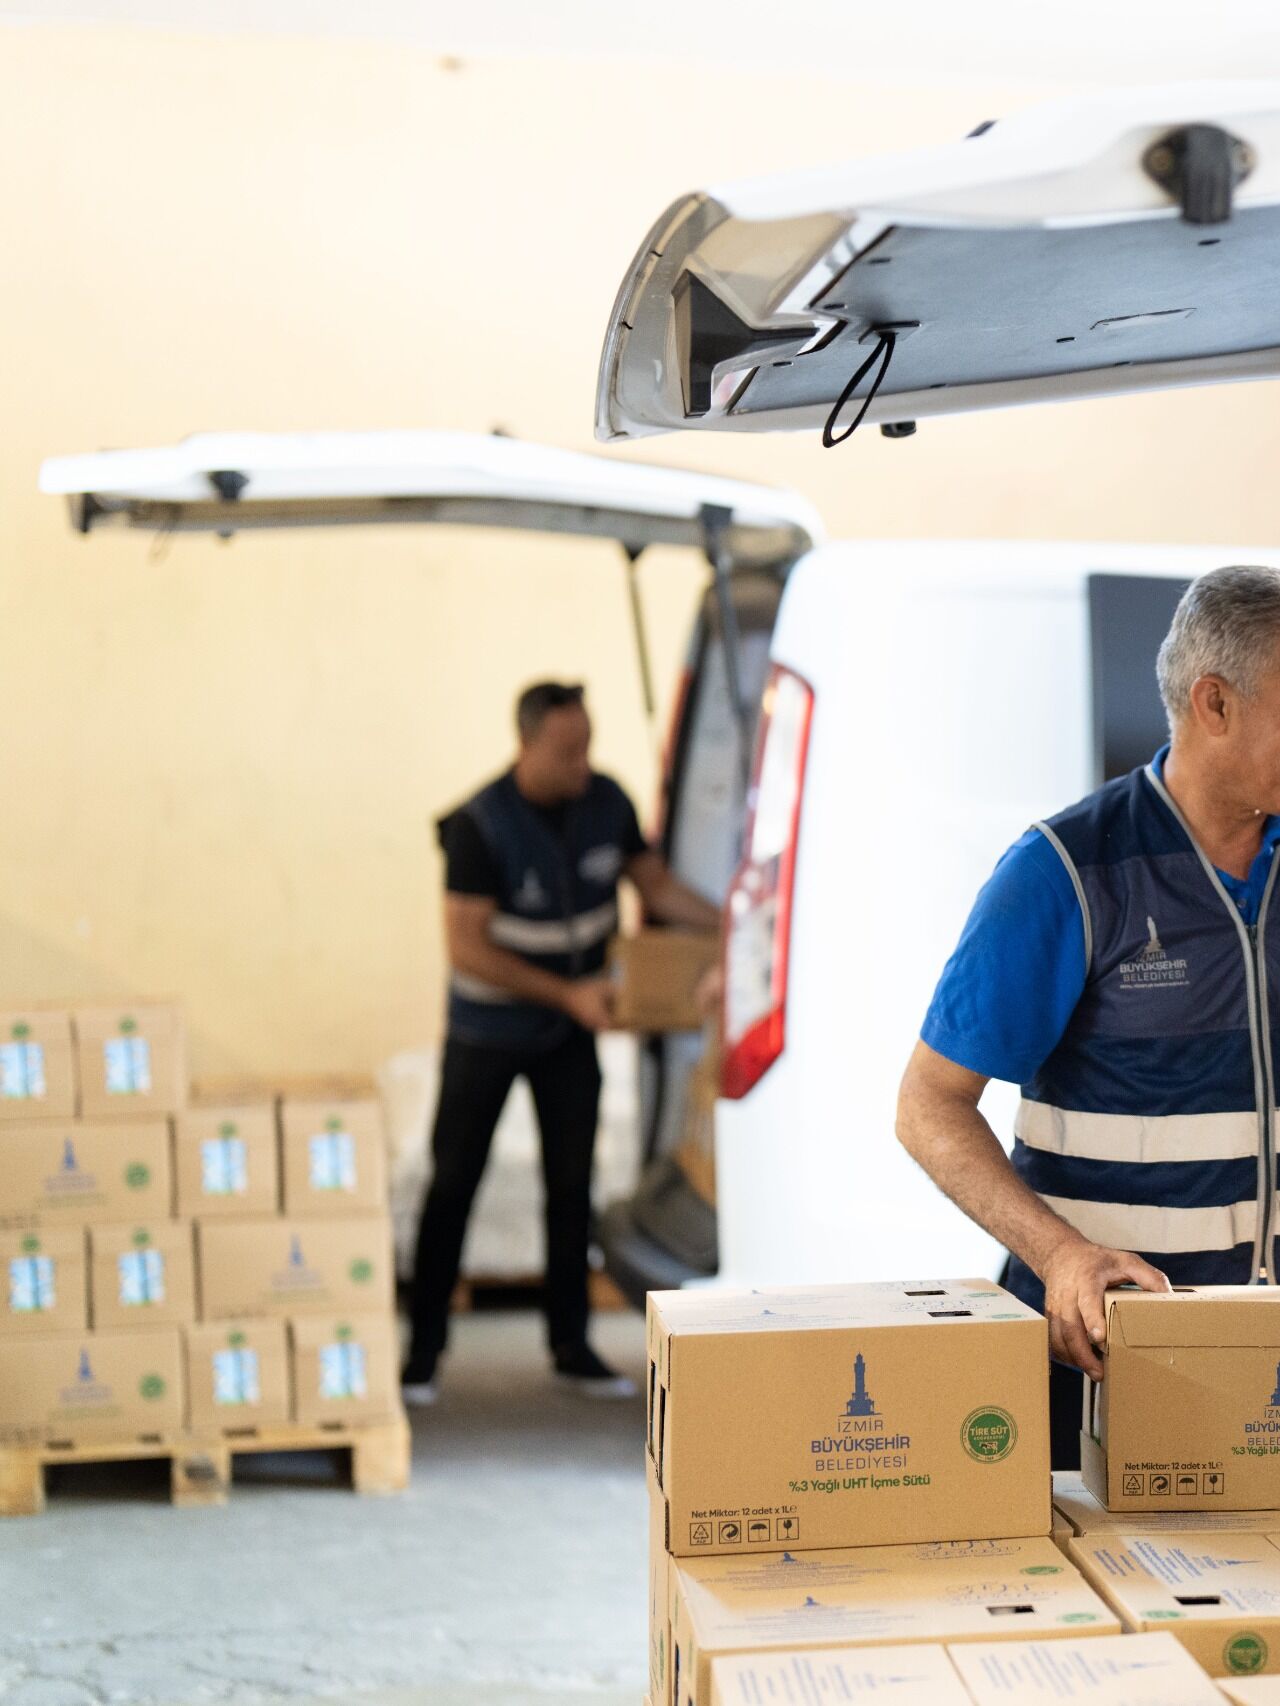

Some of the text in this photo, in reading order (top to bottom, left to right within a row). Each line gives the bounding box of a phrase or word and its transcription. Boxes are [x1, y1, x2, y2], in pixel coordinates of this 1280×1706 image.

[838, 1417, 884, 1433] İZMİR
[811, 1433, 910, 1453] BÜYÜKŞEHİR
[1231, 1446, 1246, 1455] %3
[1247, 1446, 1268, 1457] Yağlı
[815, 1453, 907, 1471] BELEDİYESİ
[1124, 1462, 1139, 1470] Net
[1141, 1462, 1170, 1470] Miktar:
[1171, 1462, 1180, 1470] 12
[1181, 1462, 1201, 1470] adet
[788, 1474, 931, 1494] %3 Yağlı UHT İçme Sütü
[691, 1510, 708, 1518] Net
[709, 1508, 740, 1518] Miktar:
[741, 1507, 750, 1516] 12
[752, 1507, 773, 1516] adet
